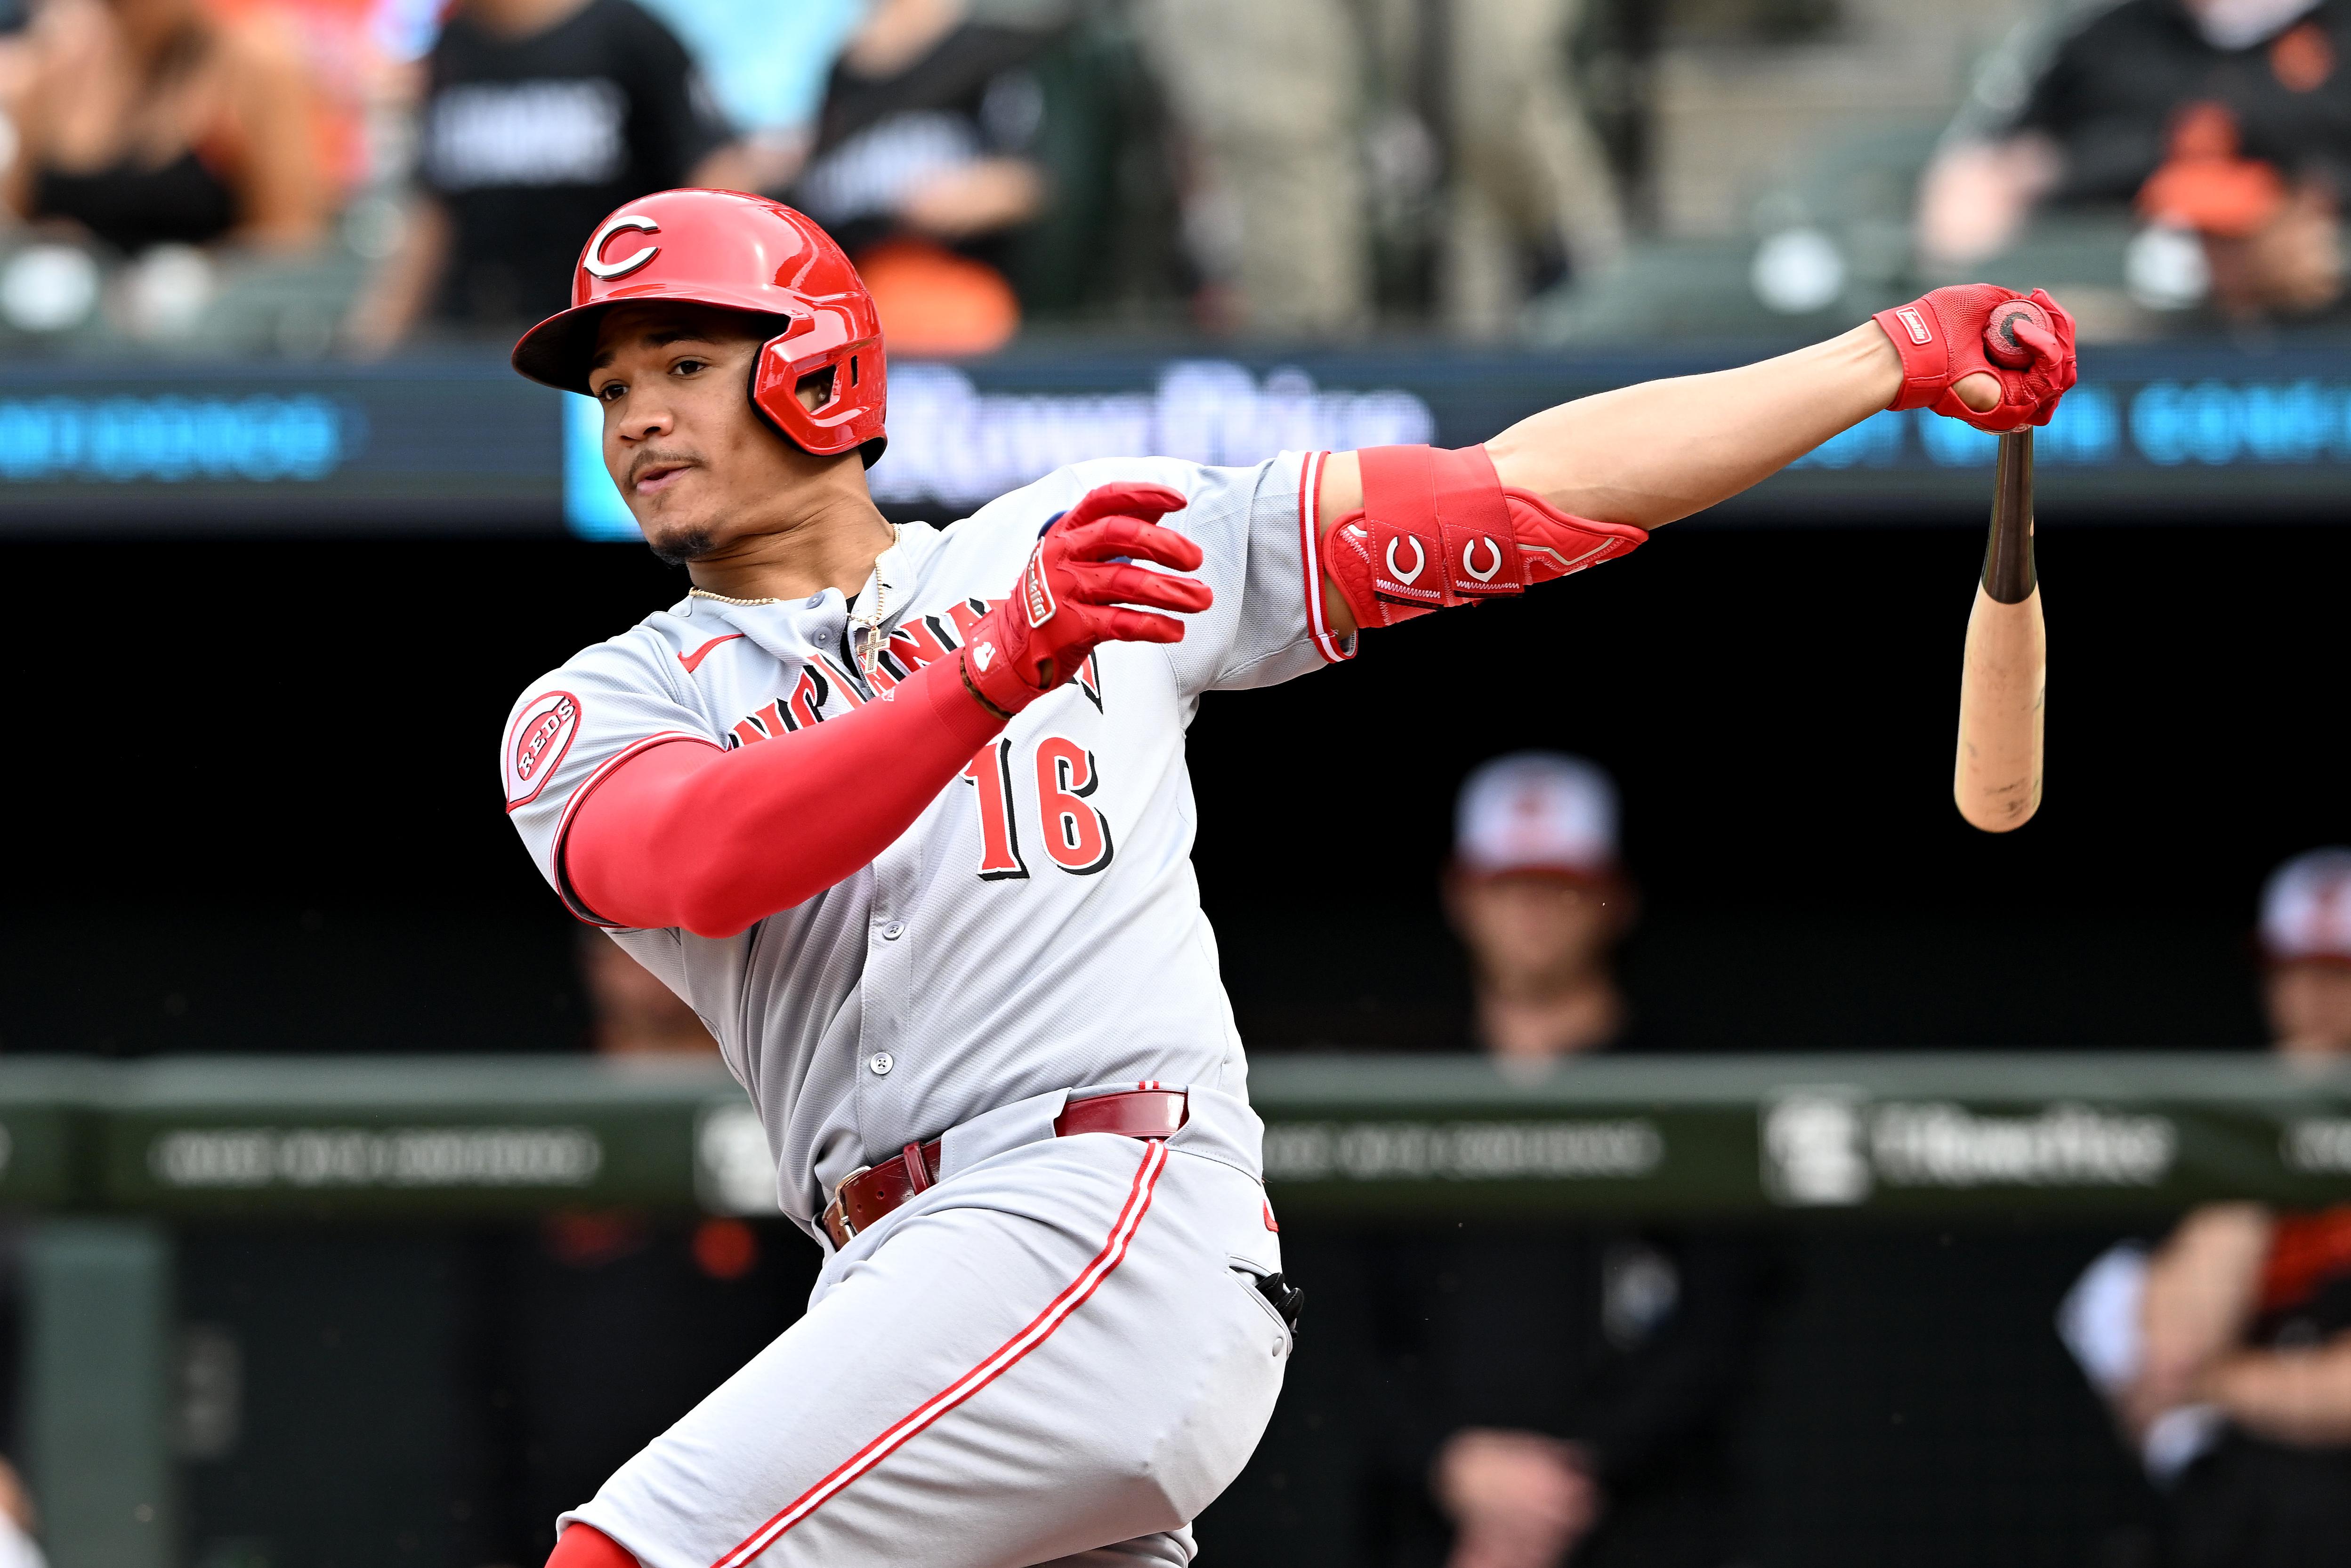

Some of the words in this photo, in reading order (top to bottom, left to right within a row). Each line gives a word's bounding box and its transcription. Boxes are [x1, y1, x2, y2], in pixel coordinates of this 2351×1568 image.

[583, 215, 659, 279] C
[1386, 535, 1425, 585] C
[1463, 537, 1502, 582] C
[518, 699, 575, 777] REDS
[958, 737, 1114, 880] 16
